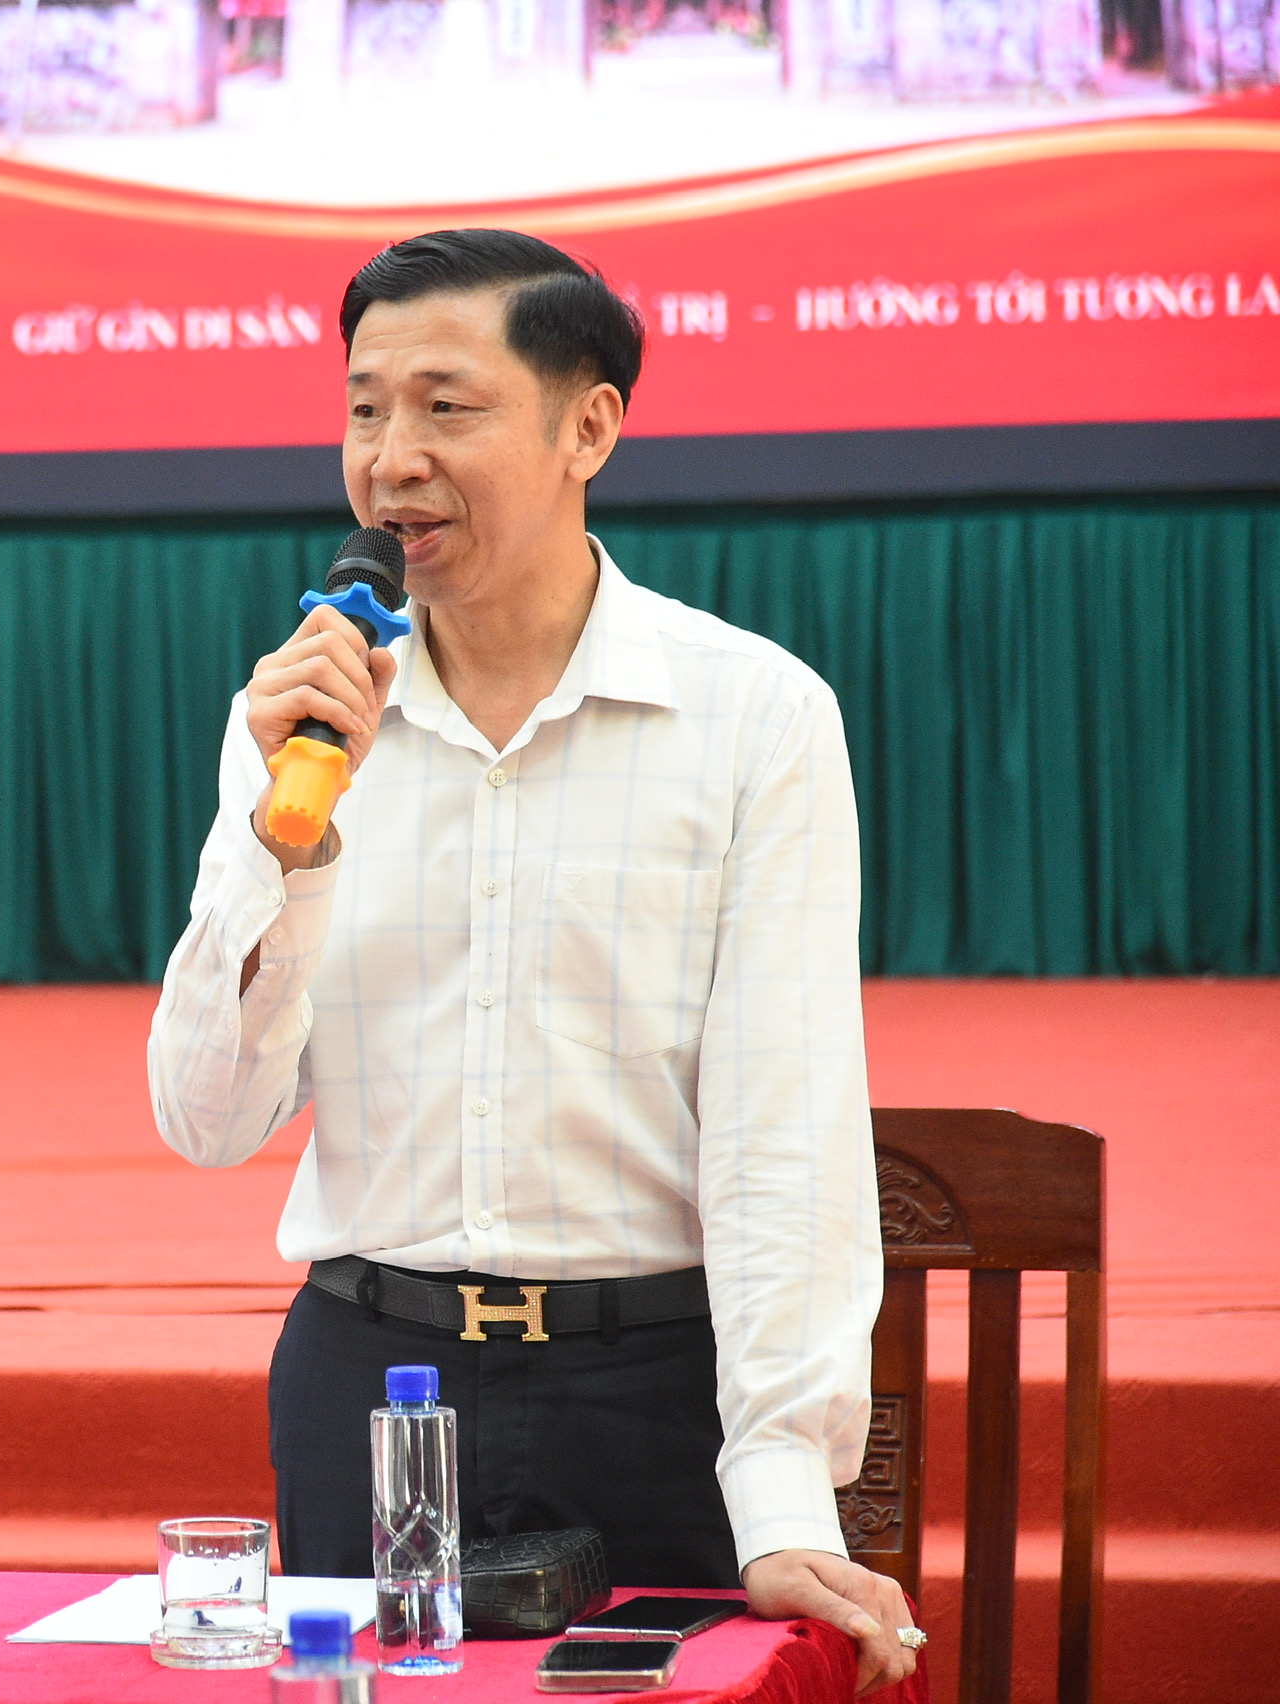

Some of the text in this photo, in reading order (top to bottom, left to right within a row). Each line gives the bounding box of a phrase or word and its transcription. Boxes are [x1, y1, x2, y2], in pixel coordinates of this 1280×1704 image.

[13, 292, 321, 355] GIỮ GÌN DI SẢN
[652, 290, 727, 342] TRỊ
[796, 276, 959, 331] HƯỚNG
[966, 269, 1046, 324] TỚI
[1054, 271, 1214, 322] TƯƠNG
